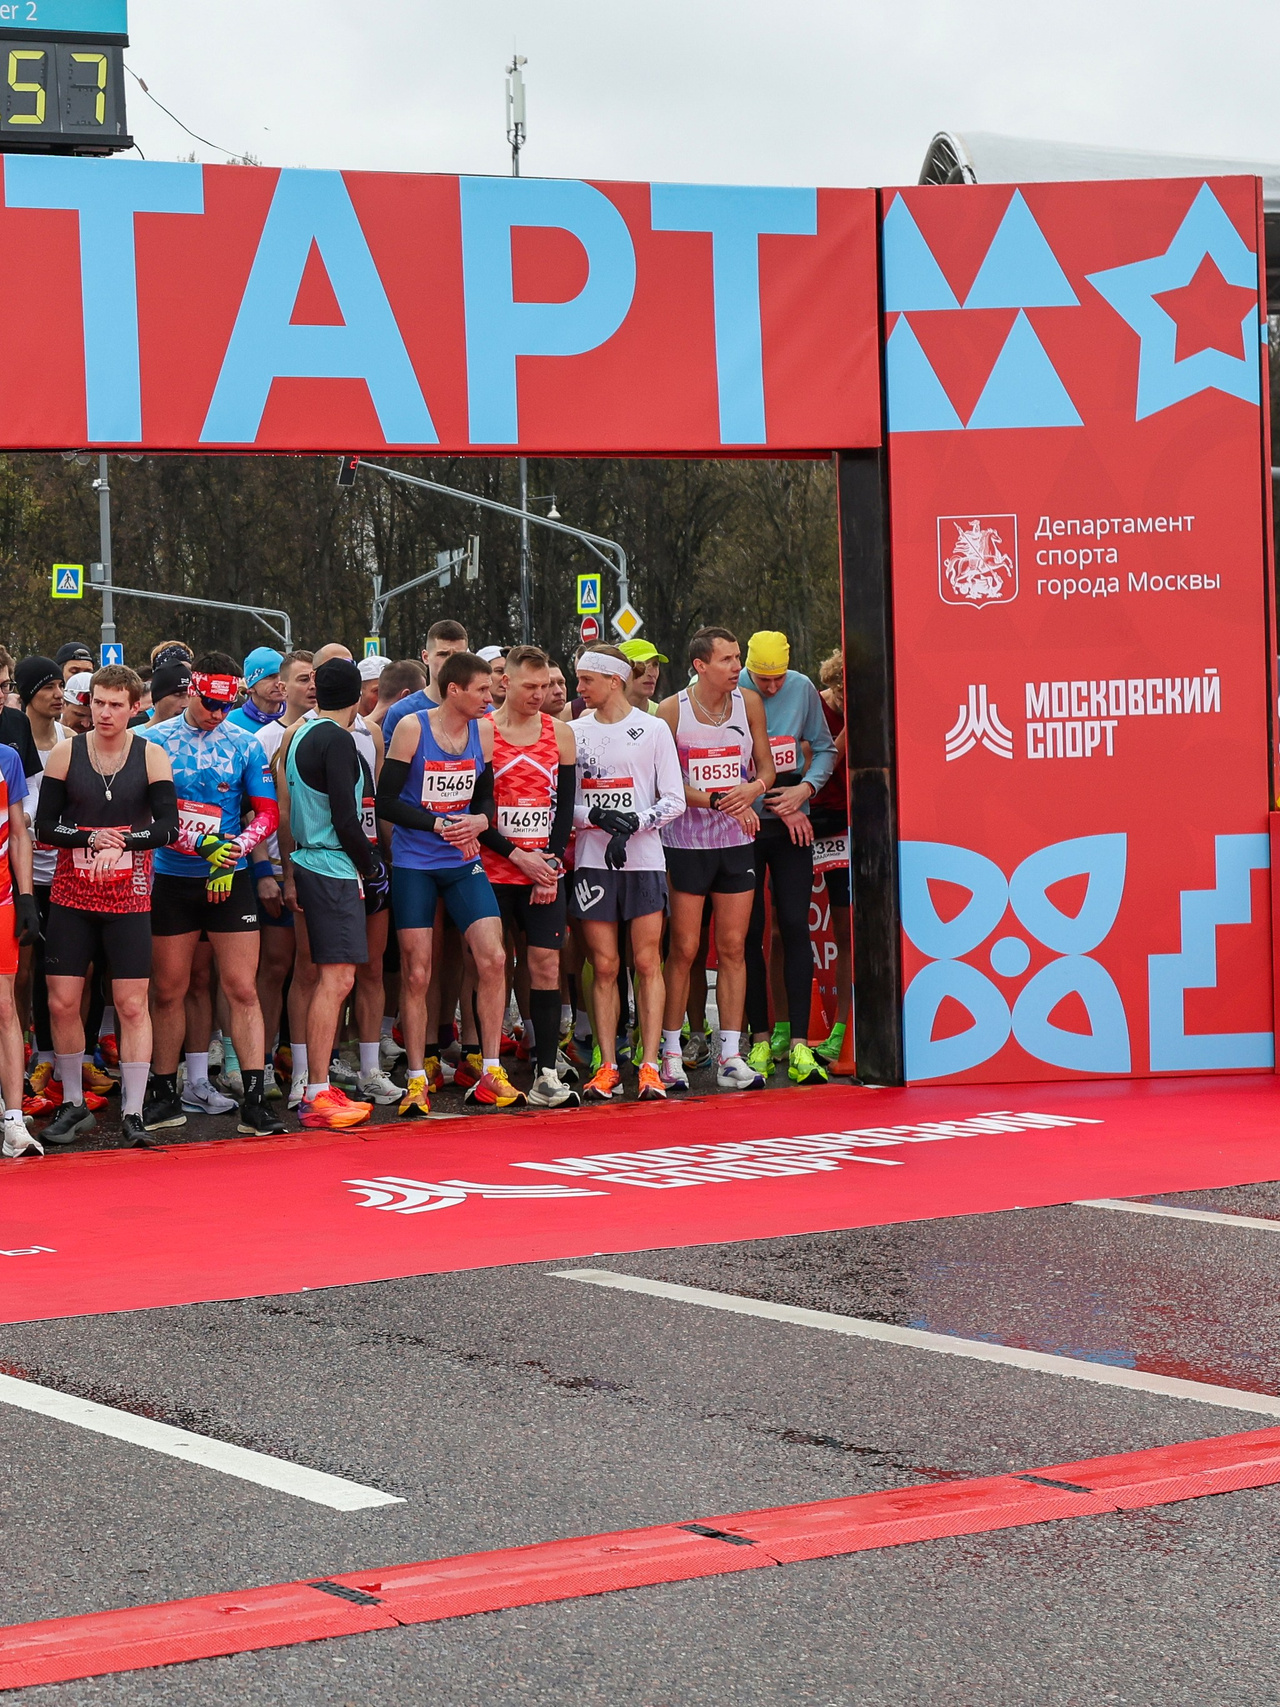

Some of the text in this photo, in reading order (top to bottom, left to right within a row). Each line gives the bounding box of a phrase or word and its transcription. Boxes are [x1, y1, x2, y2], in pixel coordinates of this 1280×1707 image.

[25, 1, 38, 21] 2
[1034, 515, 1195, 541] Департамент
[1035, 547, 1119, 570] спорта
[1036, 571, 1221, 600] города Москвы
[1025, 668, 1221, 719] МОСКОВСКИЙ
[1026, 720, 1119, 759] СПОРТ
[427, 774, 474, 791] 15465
[692, 762, 740, 781] 18535
[584, 792, 633, 809] 13298
[501, 811, 548, 827] 14695
[508, 1110, 1106, 1176] МОСКОВСКИЙ
[588, 1151, 905, 1189] СПОРТ
